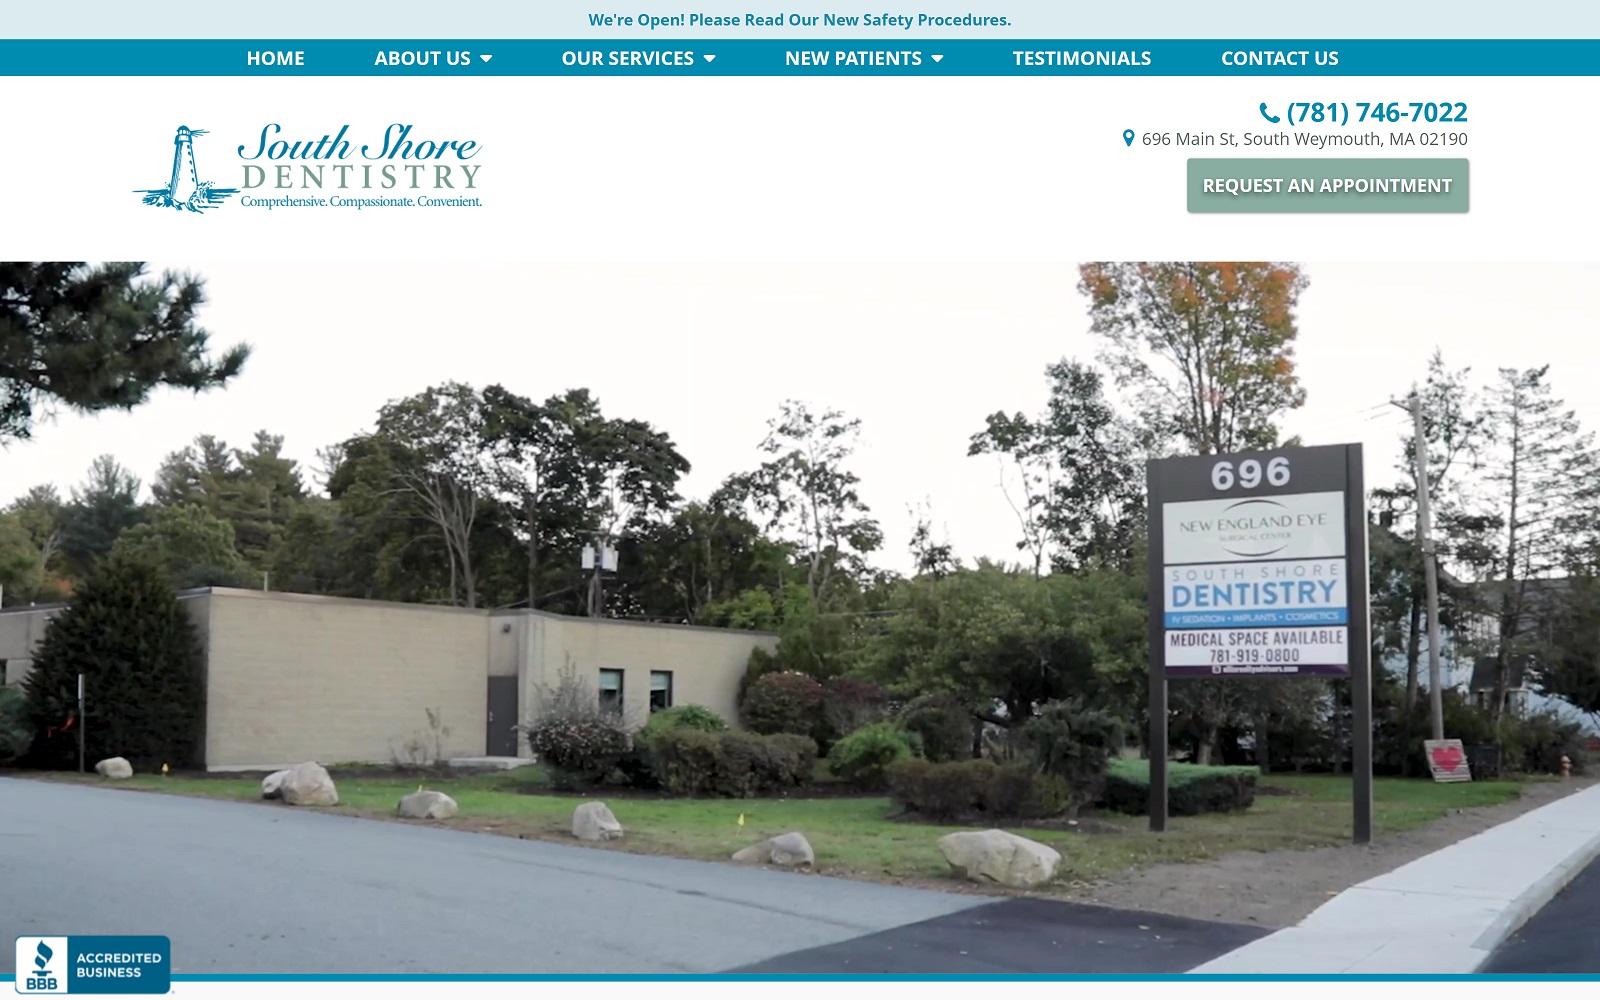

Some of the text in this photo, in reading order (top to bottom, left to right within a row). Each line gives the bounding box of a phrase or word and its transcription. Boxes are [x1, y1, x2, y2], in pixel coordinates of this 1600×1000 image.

[1211, 456, 1291, 490] 696
[1180, 513, 1328, 533] NEW ENGLAND EYE
[1260, 532, 1292, 541] CENTER
[1172, 564, 1339, 582] SOUTH SHORE
[1172, 579, 1337, 607] DENTISTRY
[1172, 611, 1339, 624] IV SEDATION IMPLANTS COSMETICS
[1170, 630, 1343, 647] MEDICAL SPACE AVAILABLE
[1210, 648, 1300, 663] 781-919-0800
